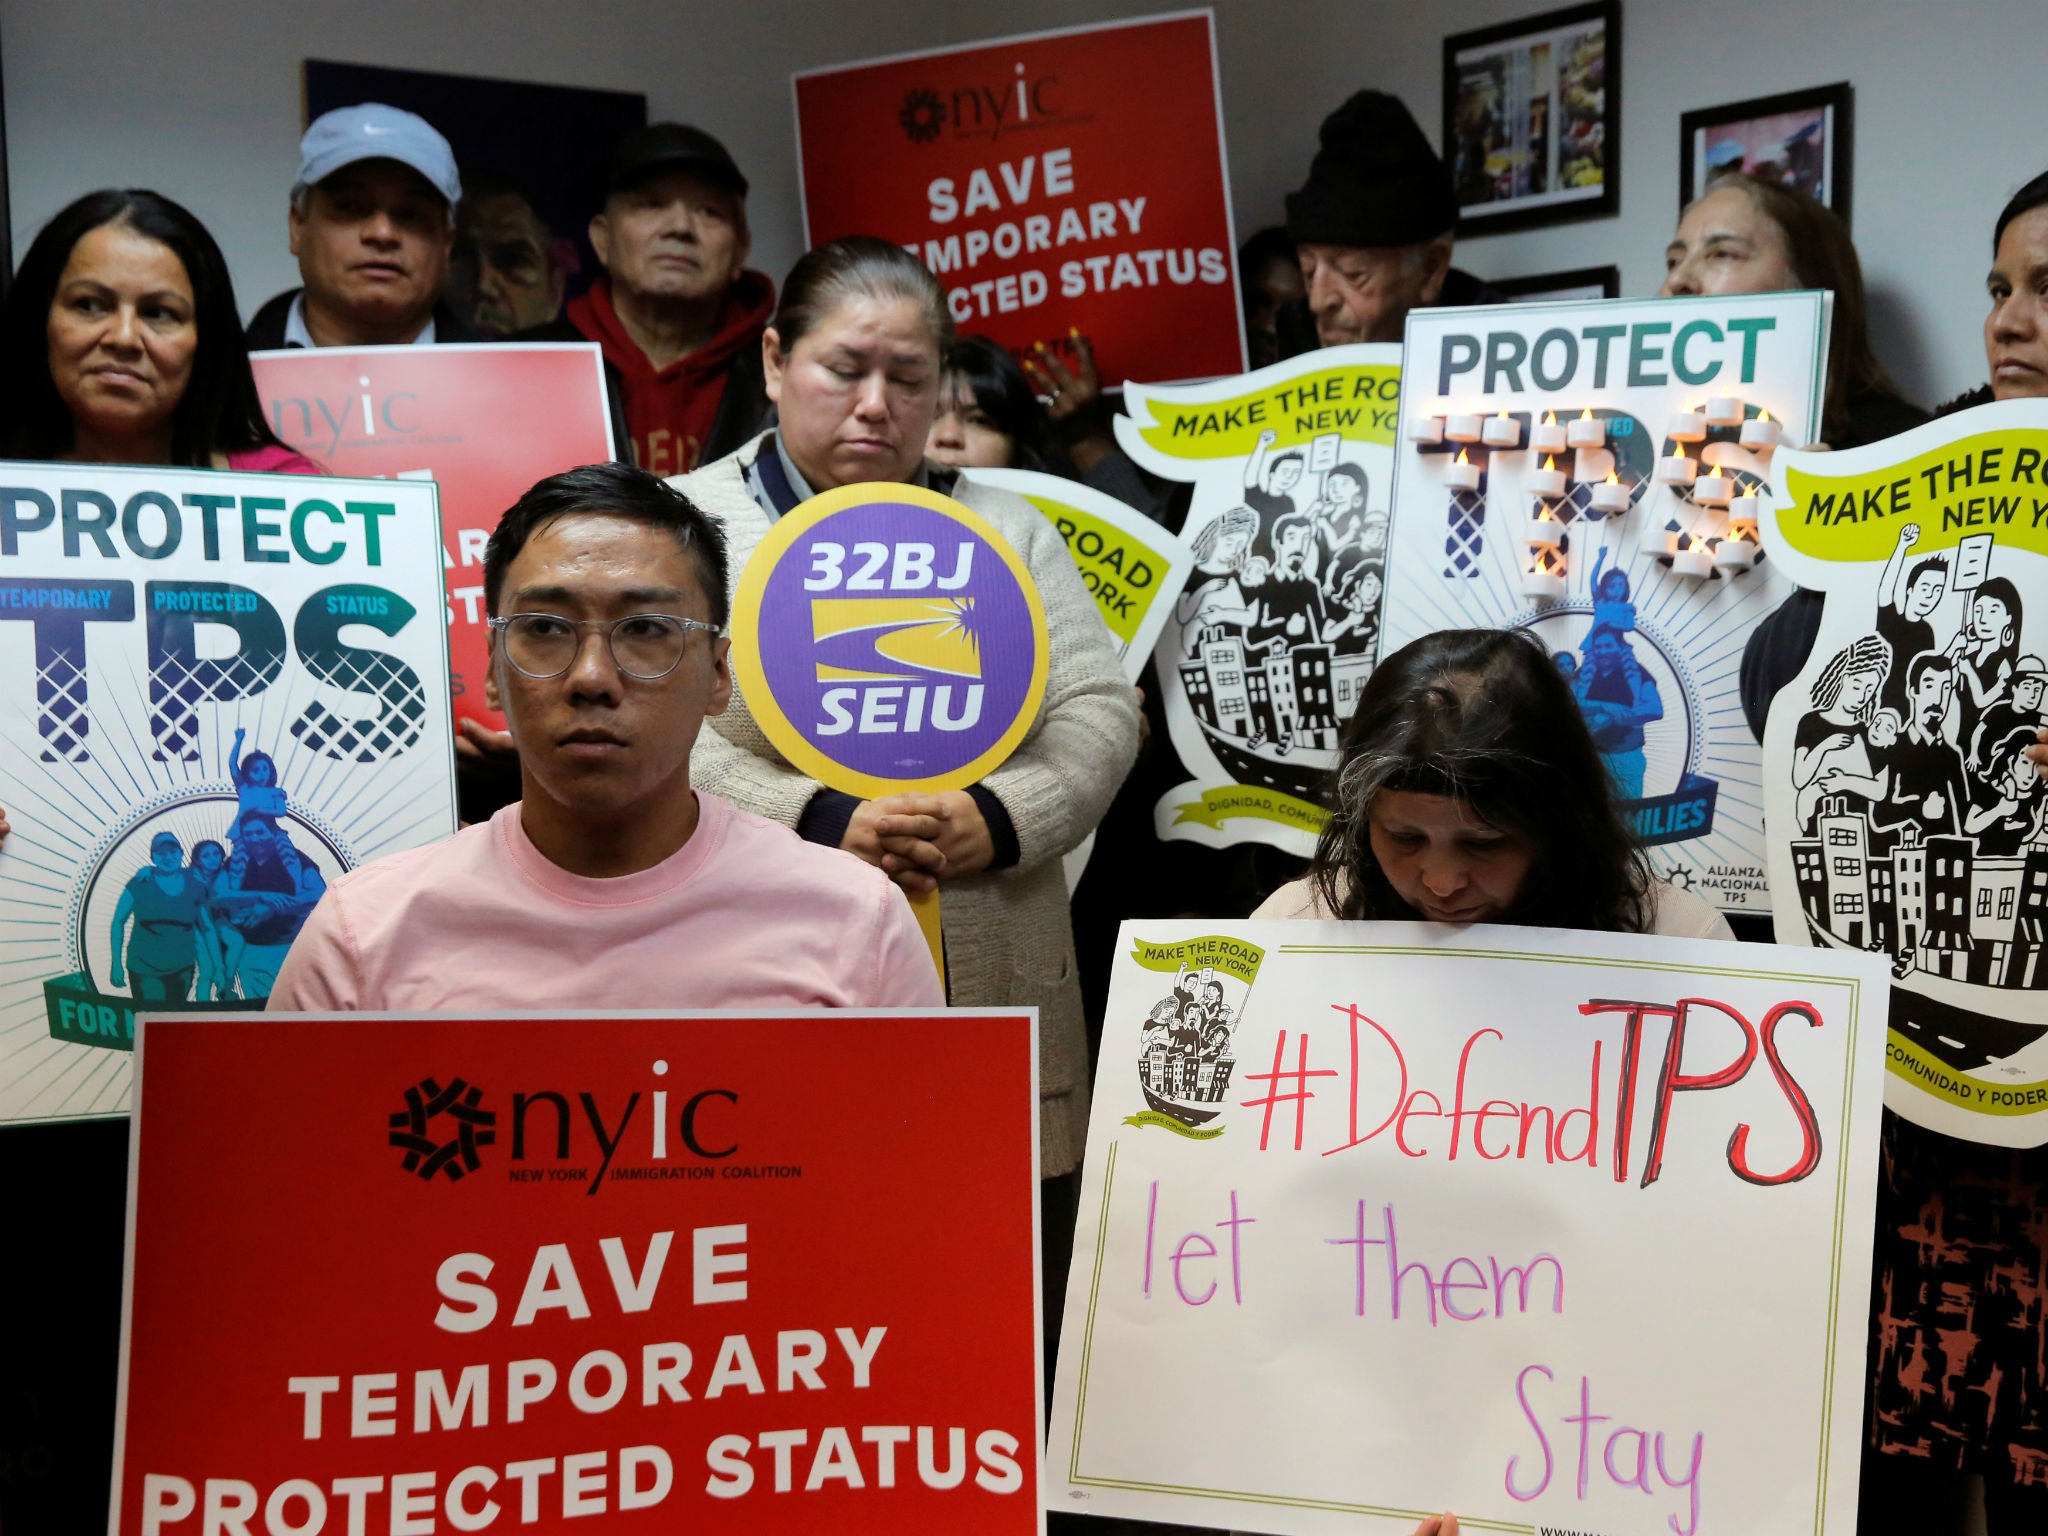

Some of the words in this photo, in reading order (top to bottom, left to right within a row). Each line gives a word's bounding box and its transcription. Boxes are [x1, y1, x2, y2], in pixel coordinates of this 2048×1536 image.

[953, 62, 1062, 141] nyic
[927, 147, 1074, 223] SAVE
[901, 197, 1147, 275] MPORARY
[1060, 248, 1227, 298] STATUS
[1438, 317, 1777, 396] PROTECT
[272, 376, 421, 457] nyic
[1172, 400, 1267, 437] MAKE
[1275, 377, 1345, 413] THE
[1296, 408, 1362, 434] NEW
[1805, 477, 1912, 527] MAKE
[1920, 448, 2004, 501] THE
[1942, 496, 2022, 533] NEW
[0, 487, 396, 567] PROTECT
[1056, 517, 1153, 589] ROAD
[803, 542, 976, 591] 32BJ
[1078, 566, 1137, 620] ORK
[0, 586, 113, 610] TEMPORARY
[153, 590, 258, 613] PROTECTED
[326, 595, 389, 615] STATUS
[0, 577, 427, 763] TPS
[816, 684, 985, 736] SEIU
[1208, 797, 1275, 813] DIGNIDAD,
[1701, 878, 1771, 892] NACIONAL
[1706, 865, 1766, 879] ALIANZA
[1723, 891, 1747, 903] TPS
[1144, 946, 1185, 961] MAKE
[1188, 940, 1216, 956] THE
[1219, 941, 1260, 965] ROAD
[1195, 955, 1221, 966] NEW
[1225, 957, 1254, 977] YORK
[58, 998, 119, 1038] FOR
[1885, 1043, 1971, 1098] COMUNIDAD
[1977, 1088, 1987, 1103] Y
[1991, 1088, 2048, 1106] PODER
[511, 1059, 740, 1196] nyic
[509, 1169, 545, 1182] NEW
[548, 1169, 588, 1182] YORK
[610, 1167, 715, 1181] IMMIGRATION
[721, 1165, 802, 1180] COALITION
[1144, 1180, 1258, 1307] let
[1325, 1200, 1565, 1328] them
[433, 1223, 748, 1333] SAVE
[287, 1326, 889, 1440] TEMPORARY
[141, 1445, 675, 1536] PROTECTED
[705, 1425, 1024, 1500] STATUS
[1504, 1364, 1705, 1536] Stay
